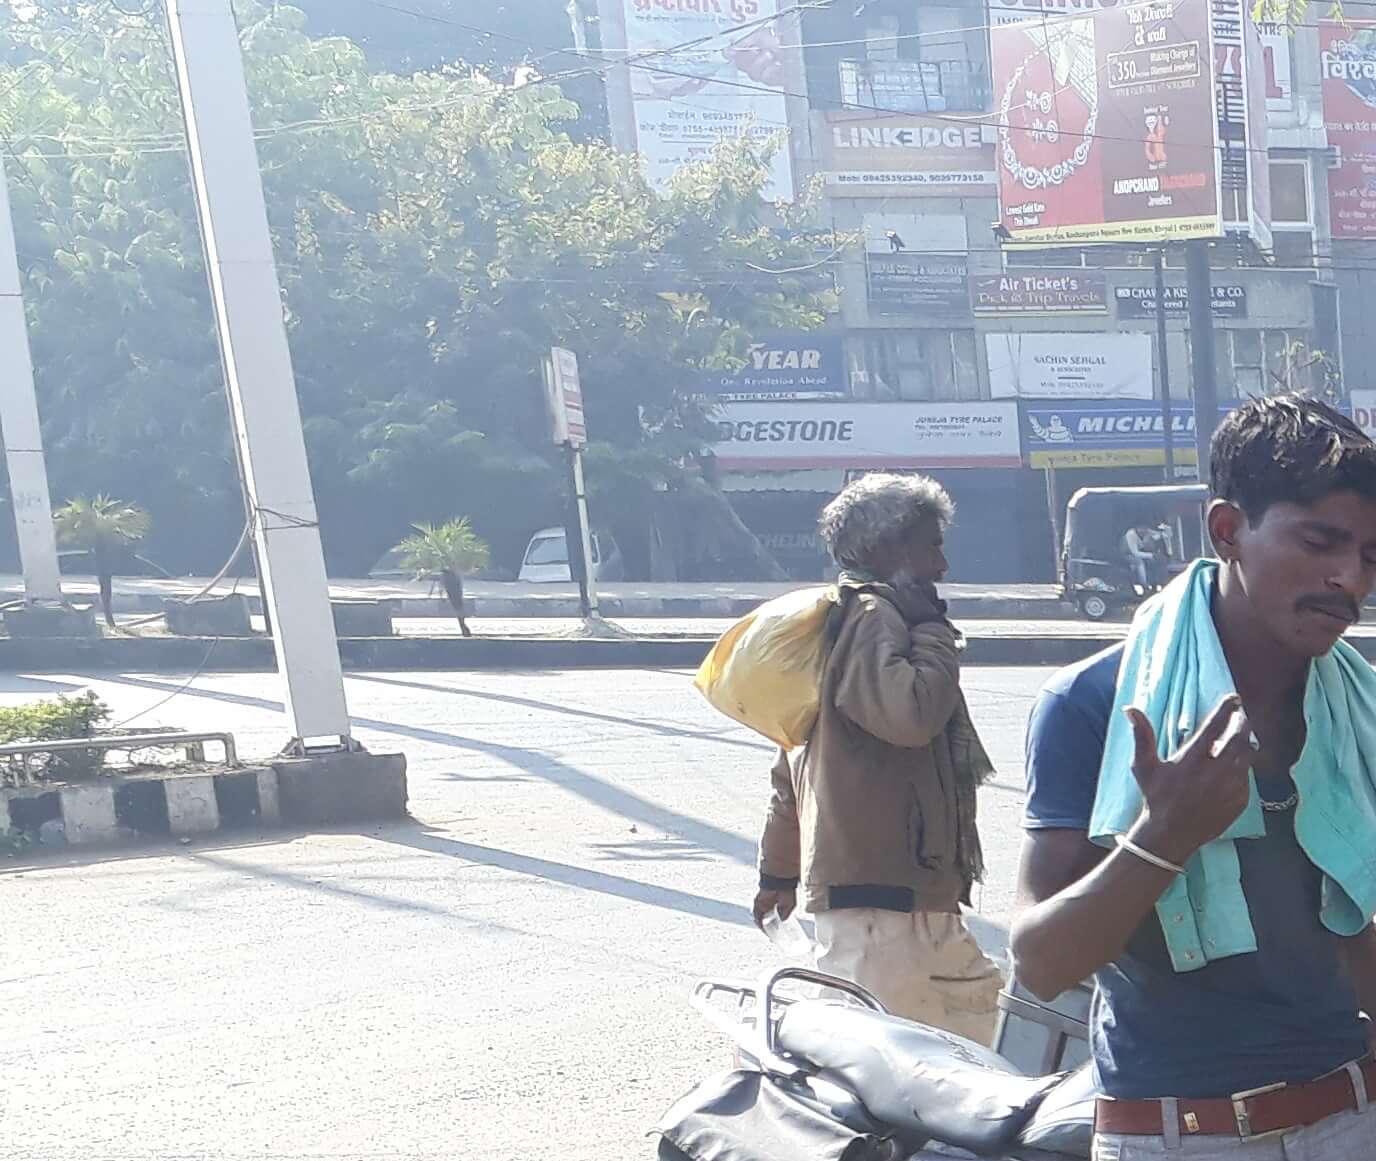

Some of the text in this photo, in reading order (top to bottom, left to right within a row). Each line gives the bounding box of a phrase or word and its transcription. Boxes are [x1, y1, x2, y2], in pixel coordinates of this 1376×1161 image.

[1117, 61, 1137, 80] 350
[832, 126, 982, 149] LINKEDGE
[999, 276, 1078, 291] Air Ticket's
[751, 350, 821, 371] YEAR
[719, 420, 853, 442] DGESTONE
